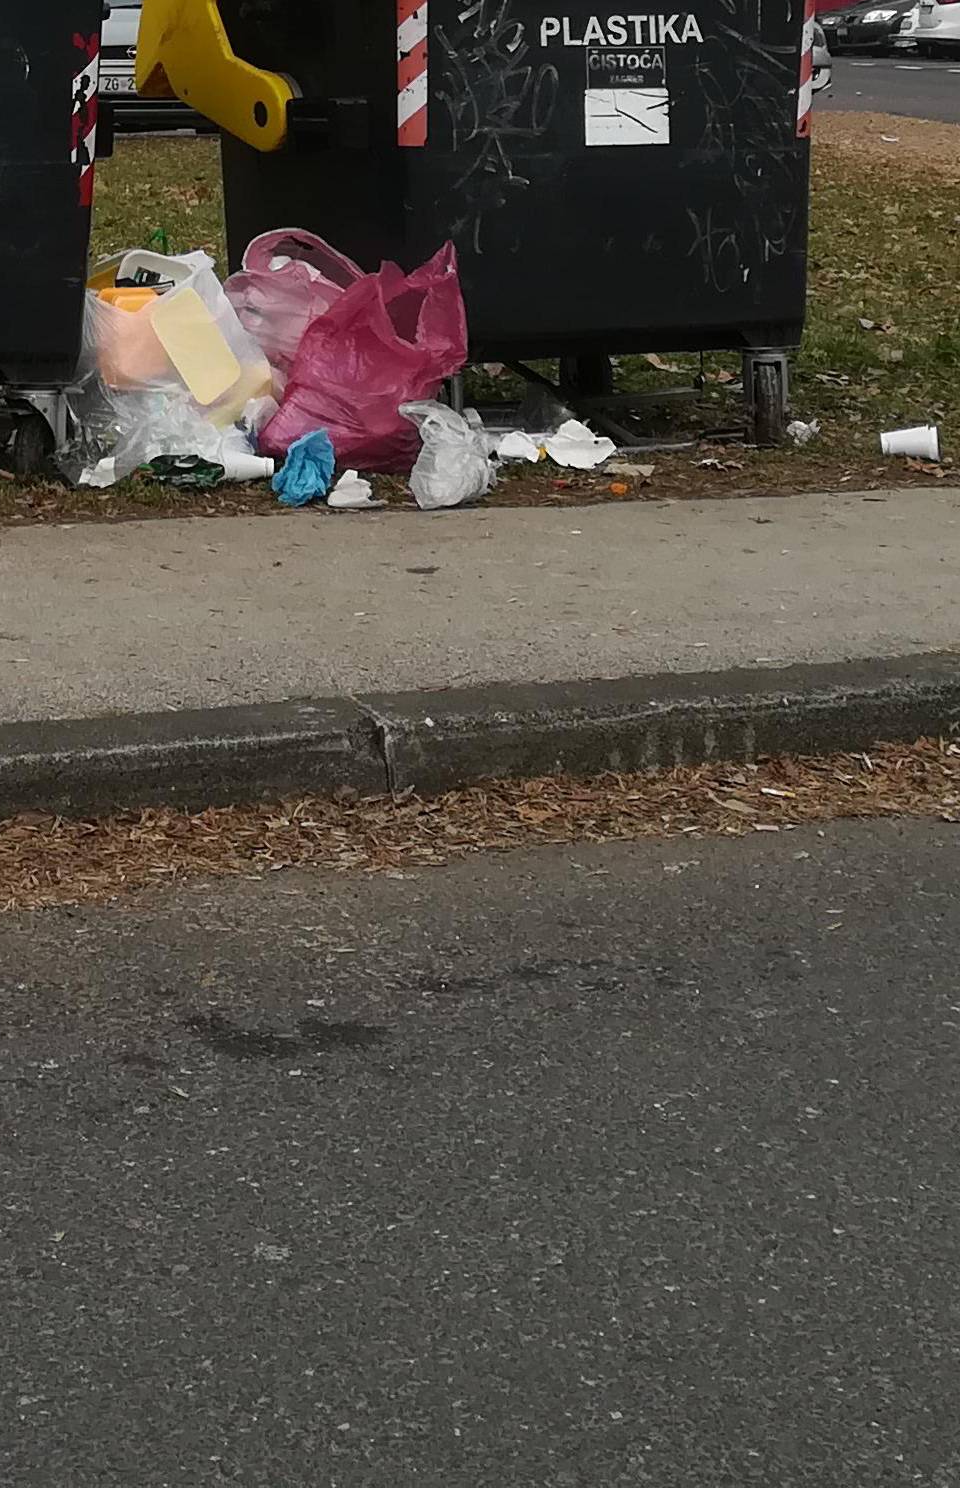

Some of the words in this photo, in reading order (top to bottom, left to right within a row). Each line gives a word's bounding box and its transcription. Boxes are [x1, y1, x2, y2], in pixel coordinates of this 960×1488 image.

[540, 14, 704, 47] PLASTIKA
[589, 49, 663, 70] ČISTOĆA
[104, 78, 119, 91] ZG
